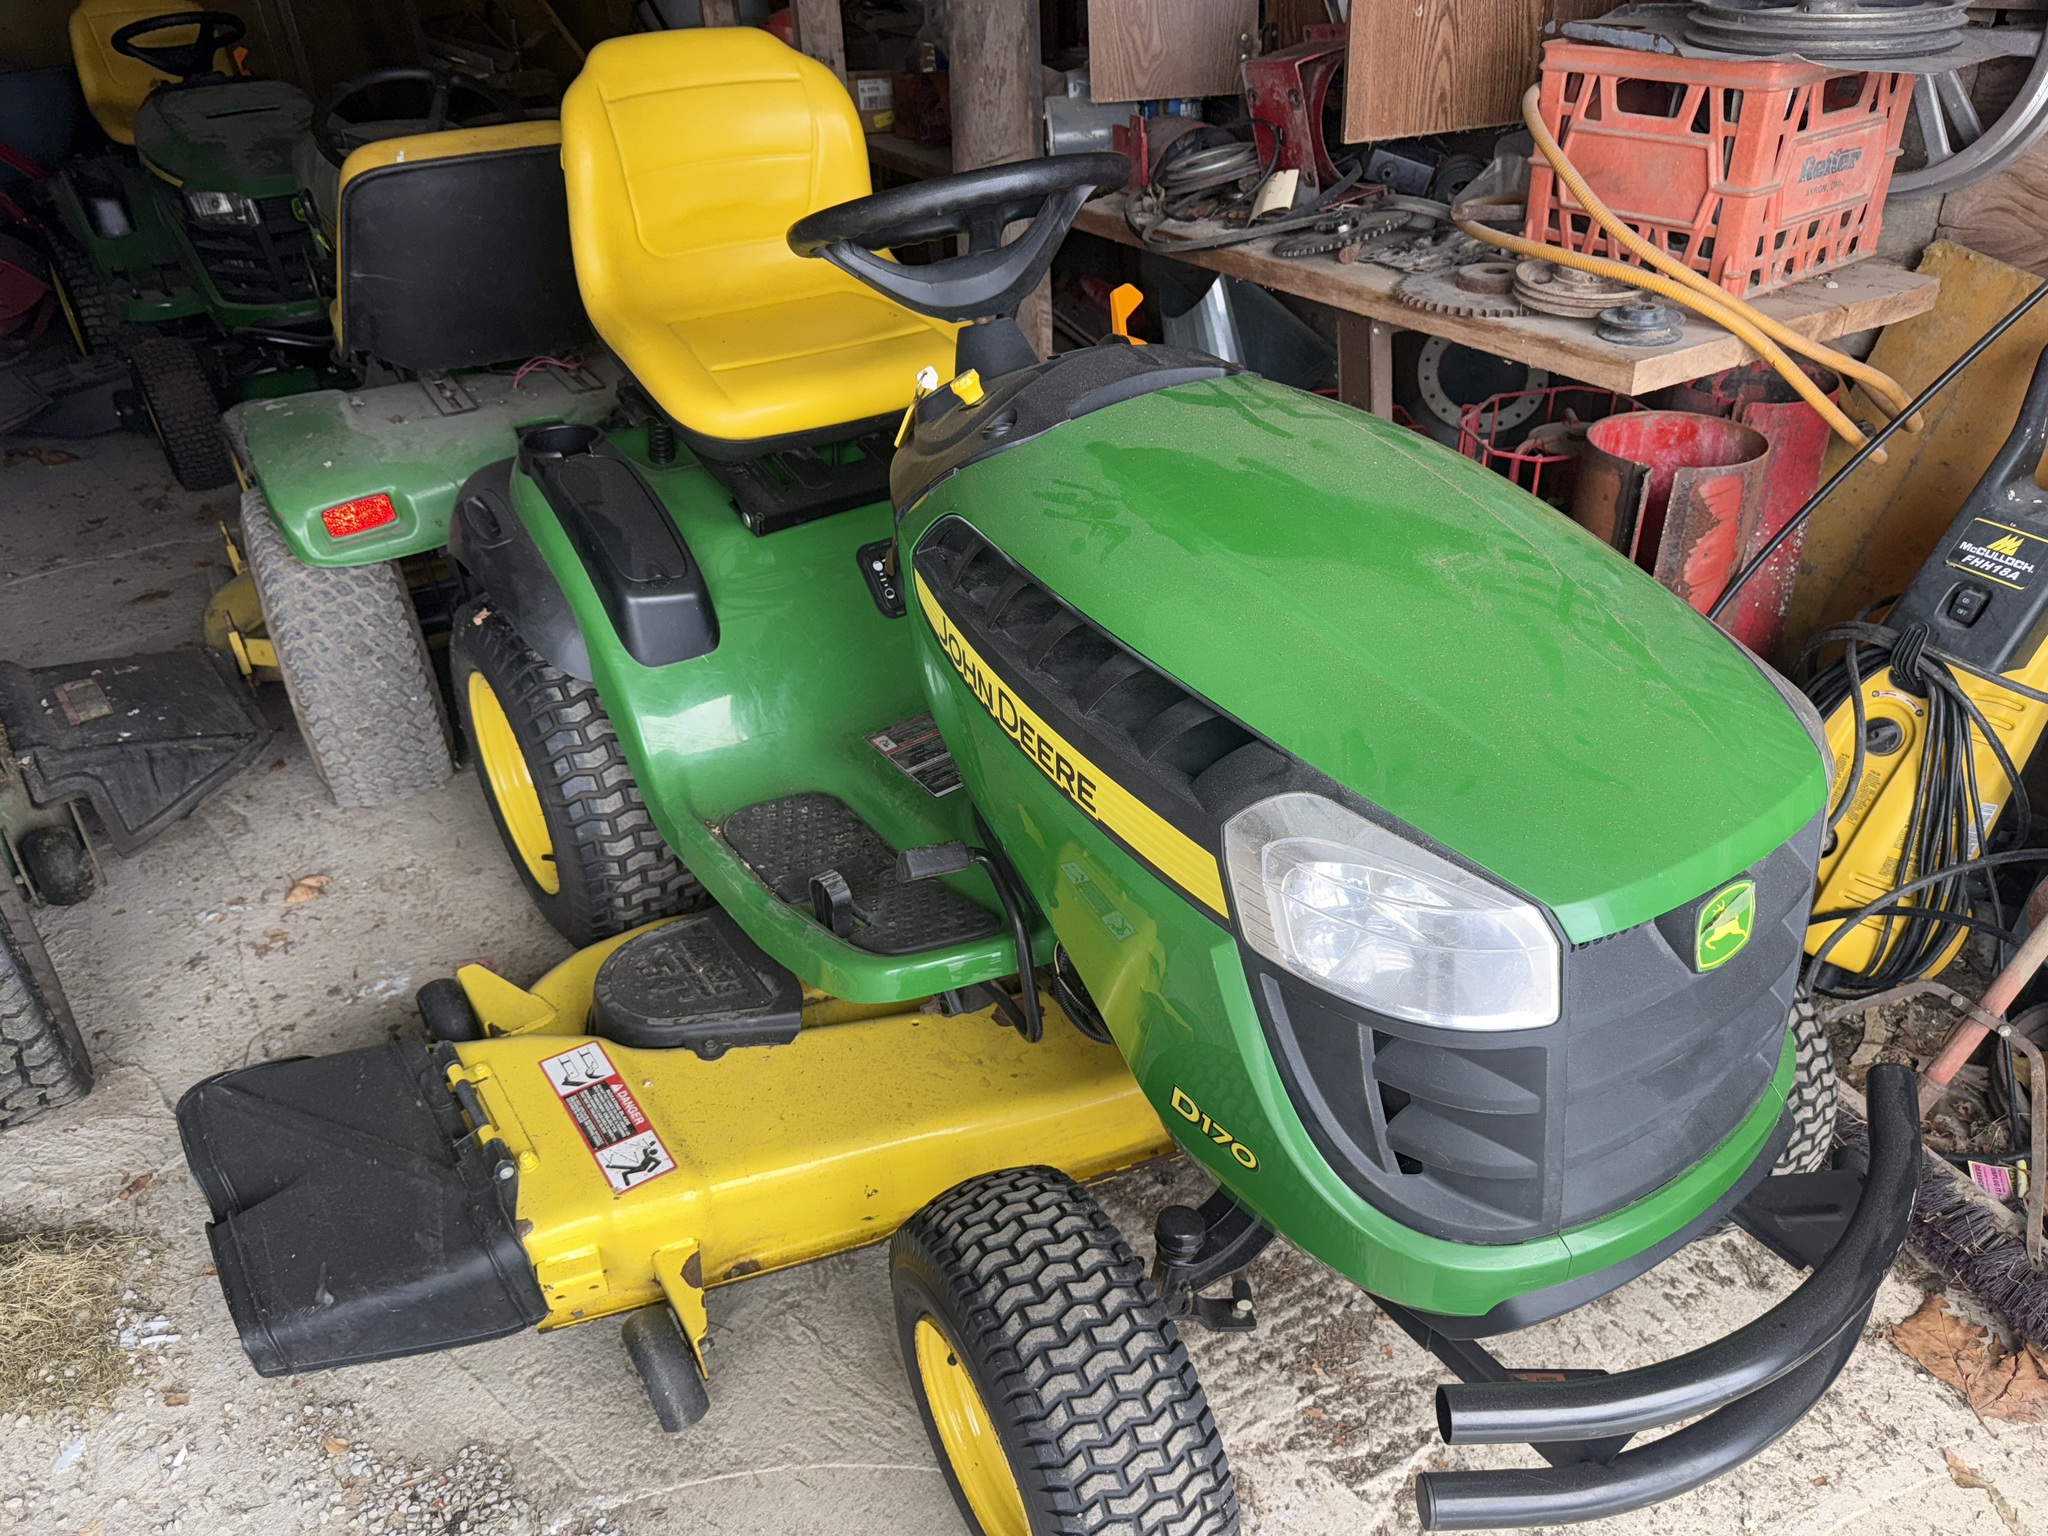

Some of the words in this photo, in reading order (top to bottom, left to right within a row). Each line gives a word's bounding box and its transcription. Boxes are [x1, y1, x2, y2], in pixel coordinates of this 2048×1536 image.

[1798, 147, 1862, 184] Reiter
[1959, 541, 2034, 573] McCULLOCH
[1961, 554, 2021, 580] FHH18A
[939, 616, 994, 711] JOHN
[998, 687, 1097, 814] DEERE
[618, 1091, 645, 1126] DANGER
[1170, 1086, 1258, 1169] D170
